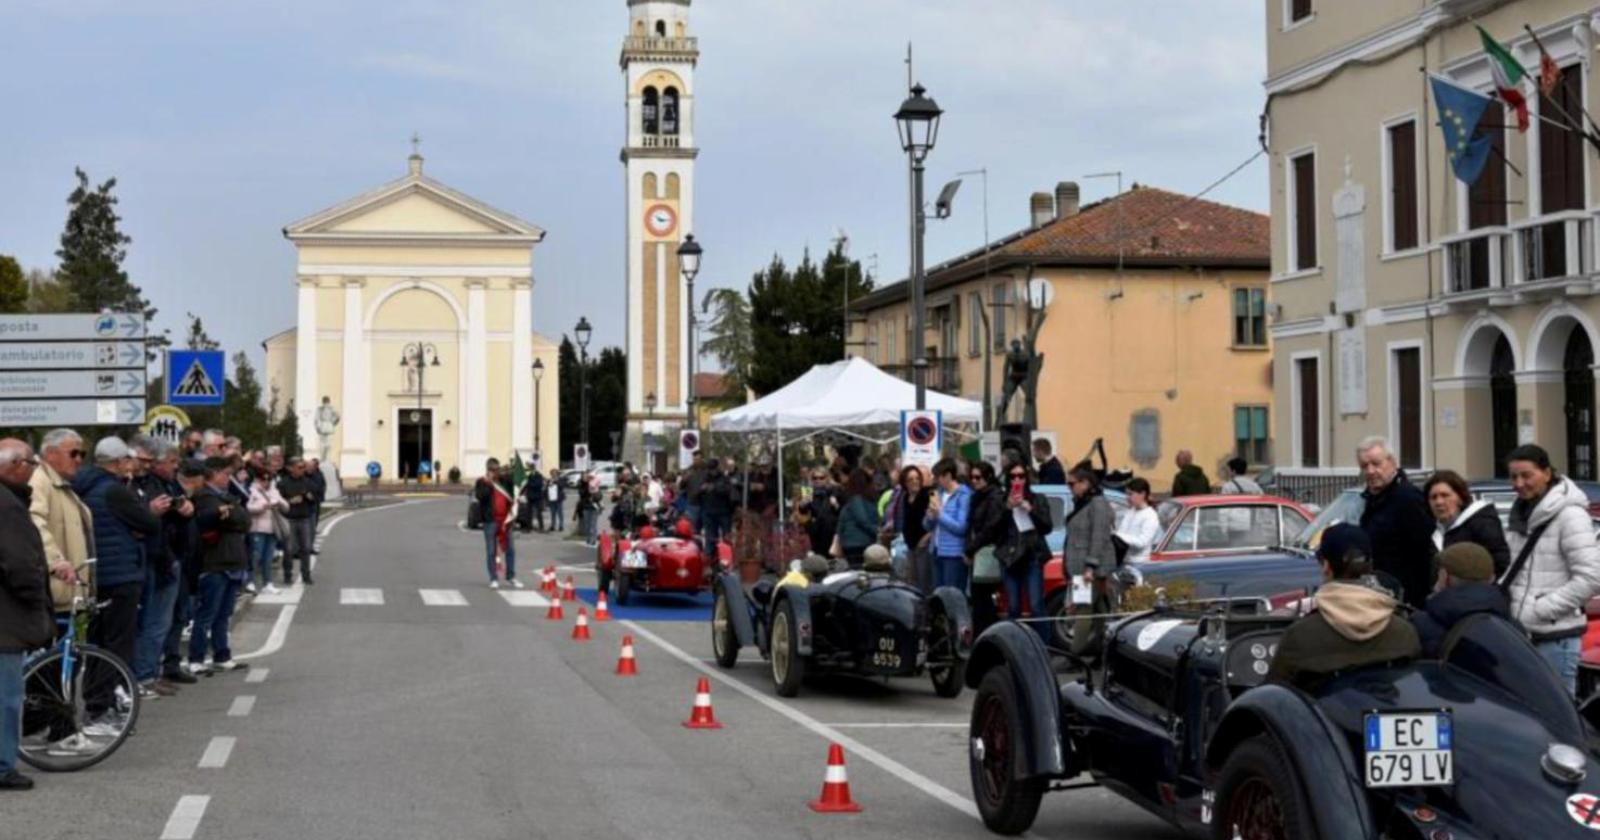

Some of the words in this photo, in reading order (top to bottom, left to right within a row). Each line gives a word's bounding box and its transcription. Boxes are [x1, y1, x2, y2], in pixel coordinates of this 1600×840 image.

[0, 320, 38, 333] posta
[0, 348, 84, 361] ambulatorio
[1394, 718, 1424, 747] EC
[1370, 754, 1413, 783] 679
[1421, 752, 1448, 782] LV
